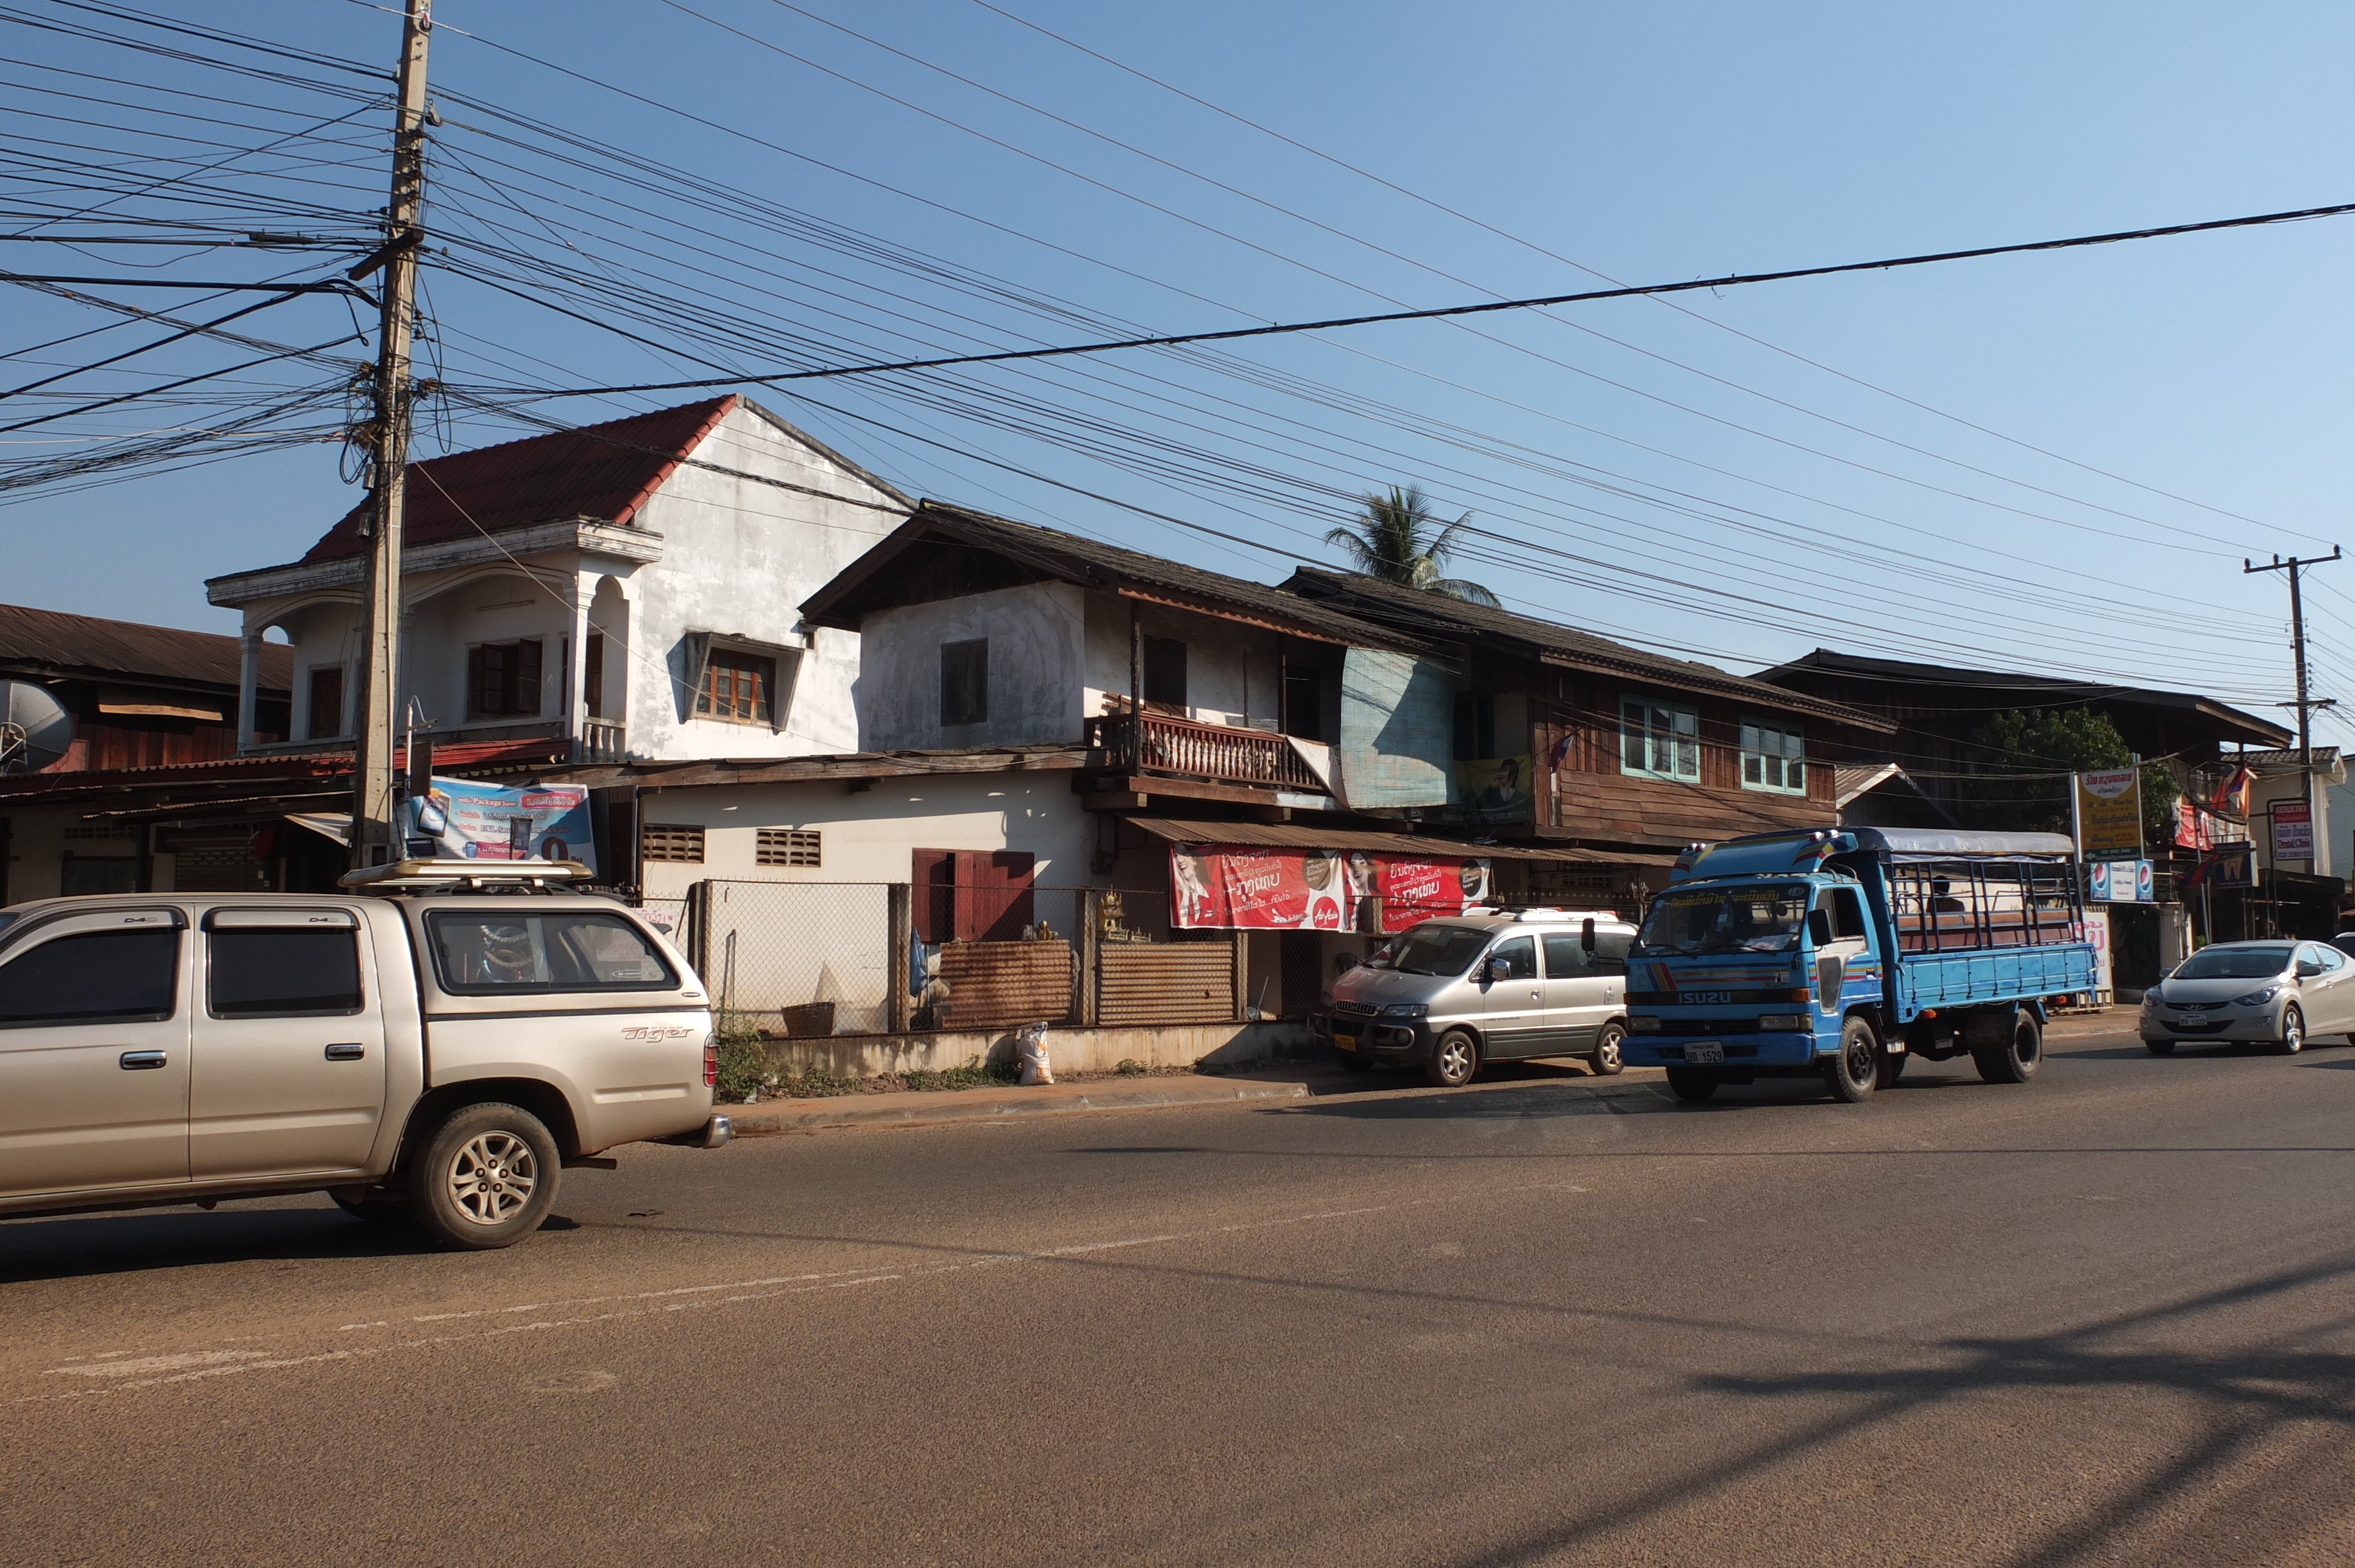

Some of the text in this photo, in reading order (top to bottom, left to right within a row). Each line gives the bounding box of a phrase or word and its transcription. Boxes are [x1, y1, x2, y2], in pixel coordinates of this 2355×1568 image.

[1679, 992, 1731, 1004] ISUZU
[622, 1026, 694, 1043] Tiger
[1702, 1051, 1722, 1062] 1529
